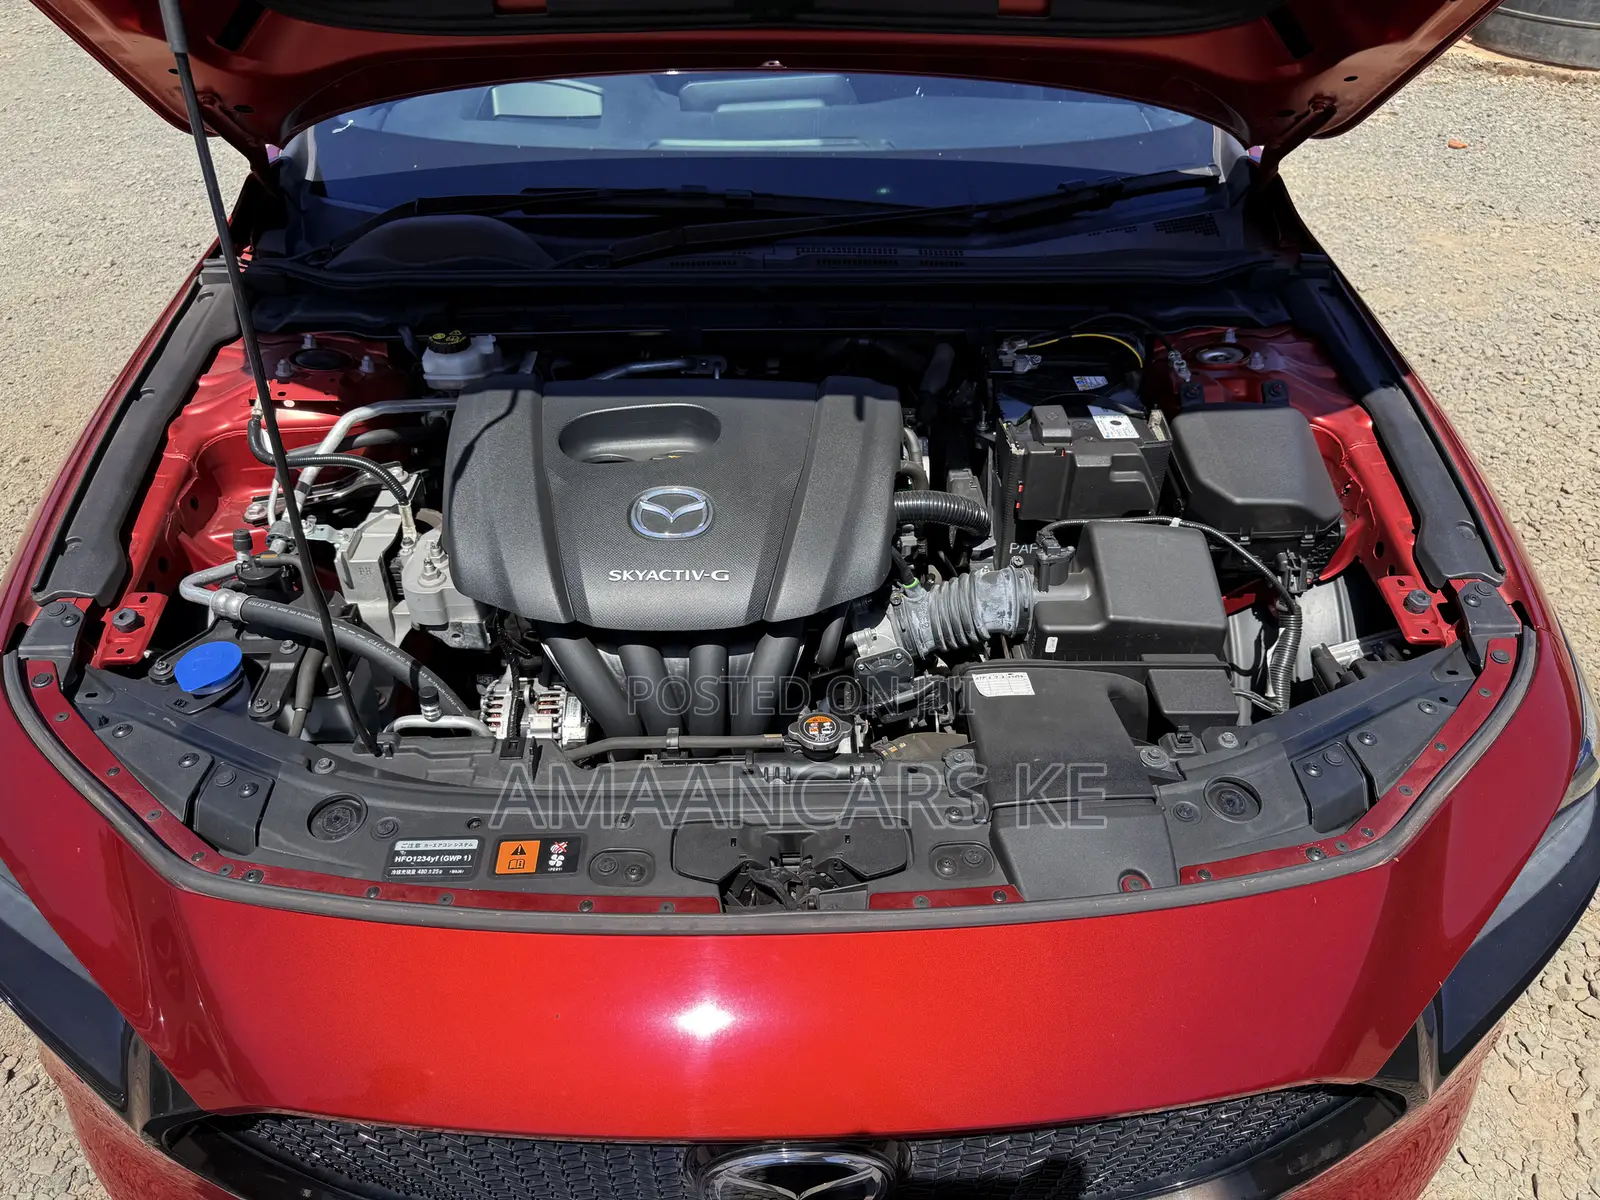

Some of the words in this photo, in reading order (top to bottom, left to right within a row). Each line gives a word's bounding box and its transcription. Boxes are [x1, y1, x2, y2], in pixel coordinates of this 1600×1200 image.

[608, 569, 730, 581] SKYACTIV-G
[367, 639, 396, 655] GALAXY
[395, 855, 440, 863] HFO1234yf
[463, 854, 472, 862] 1)
